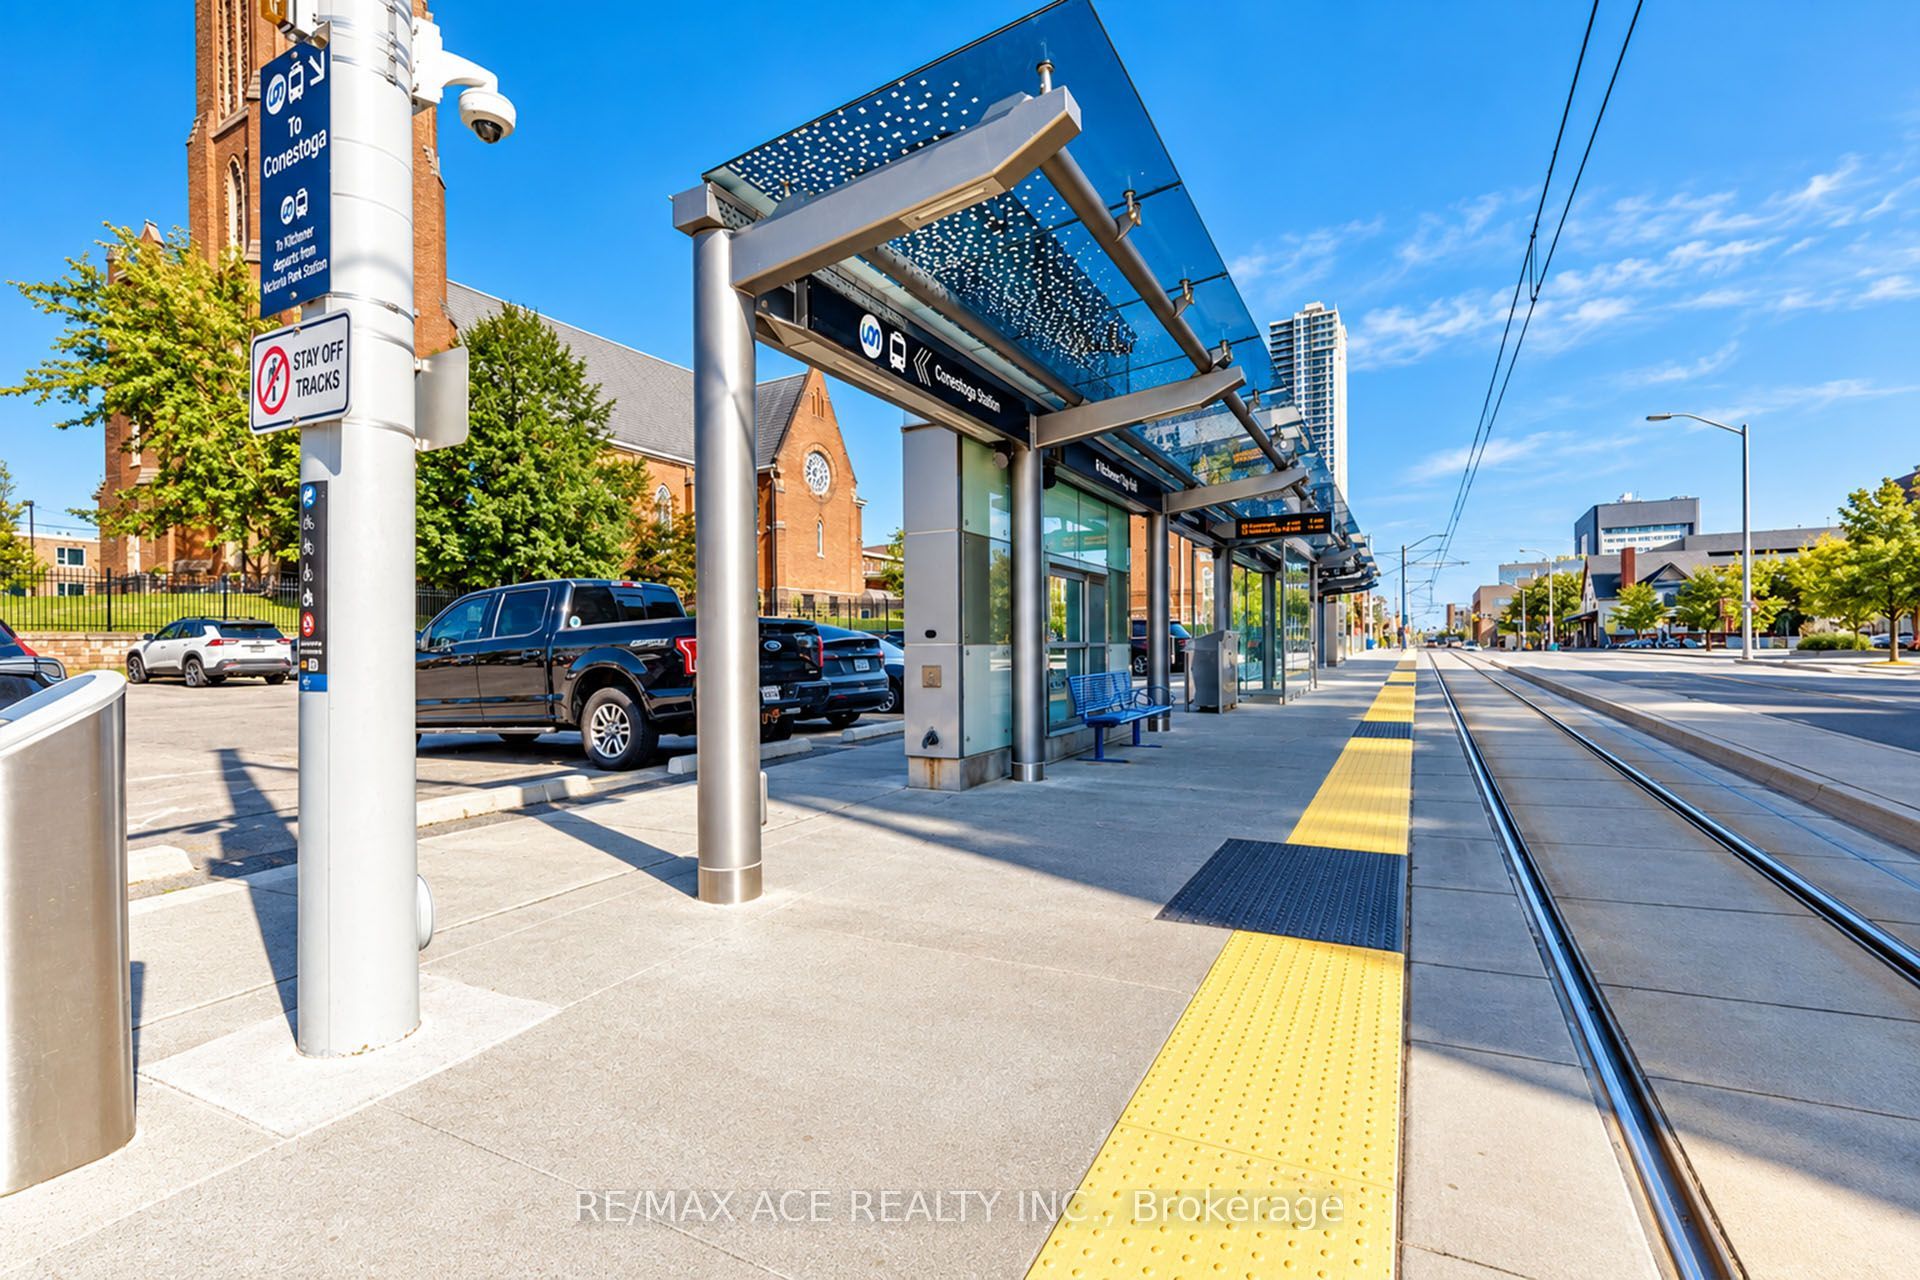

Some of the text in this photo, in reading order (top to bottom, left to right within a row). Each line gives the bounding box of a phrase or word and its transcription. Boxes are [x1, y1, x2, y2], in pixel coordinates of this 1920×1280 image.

[288, 116, 302, 138] To
[263, 129, 326, 178] Conestoga
[273, 244, 316, 274] departs from
[275, 239, 283, 252] To
[287, 267, 302, 284] Park
[303, 258, 328, 278] Station
[293, 339, 344, 371] STAY OFF
[296, 369, 340, 398] TRACKS
[935, 364, 1001, 414] Conestoga Station
